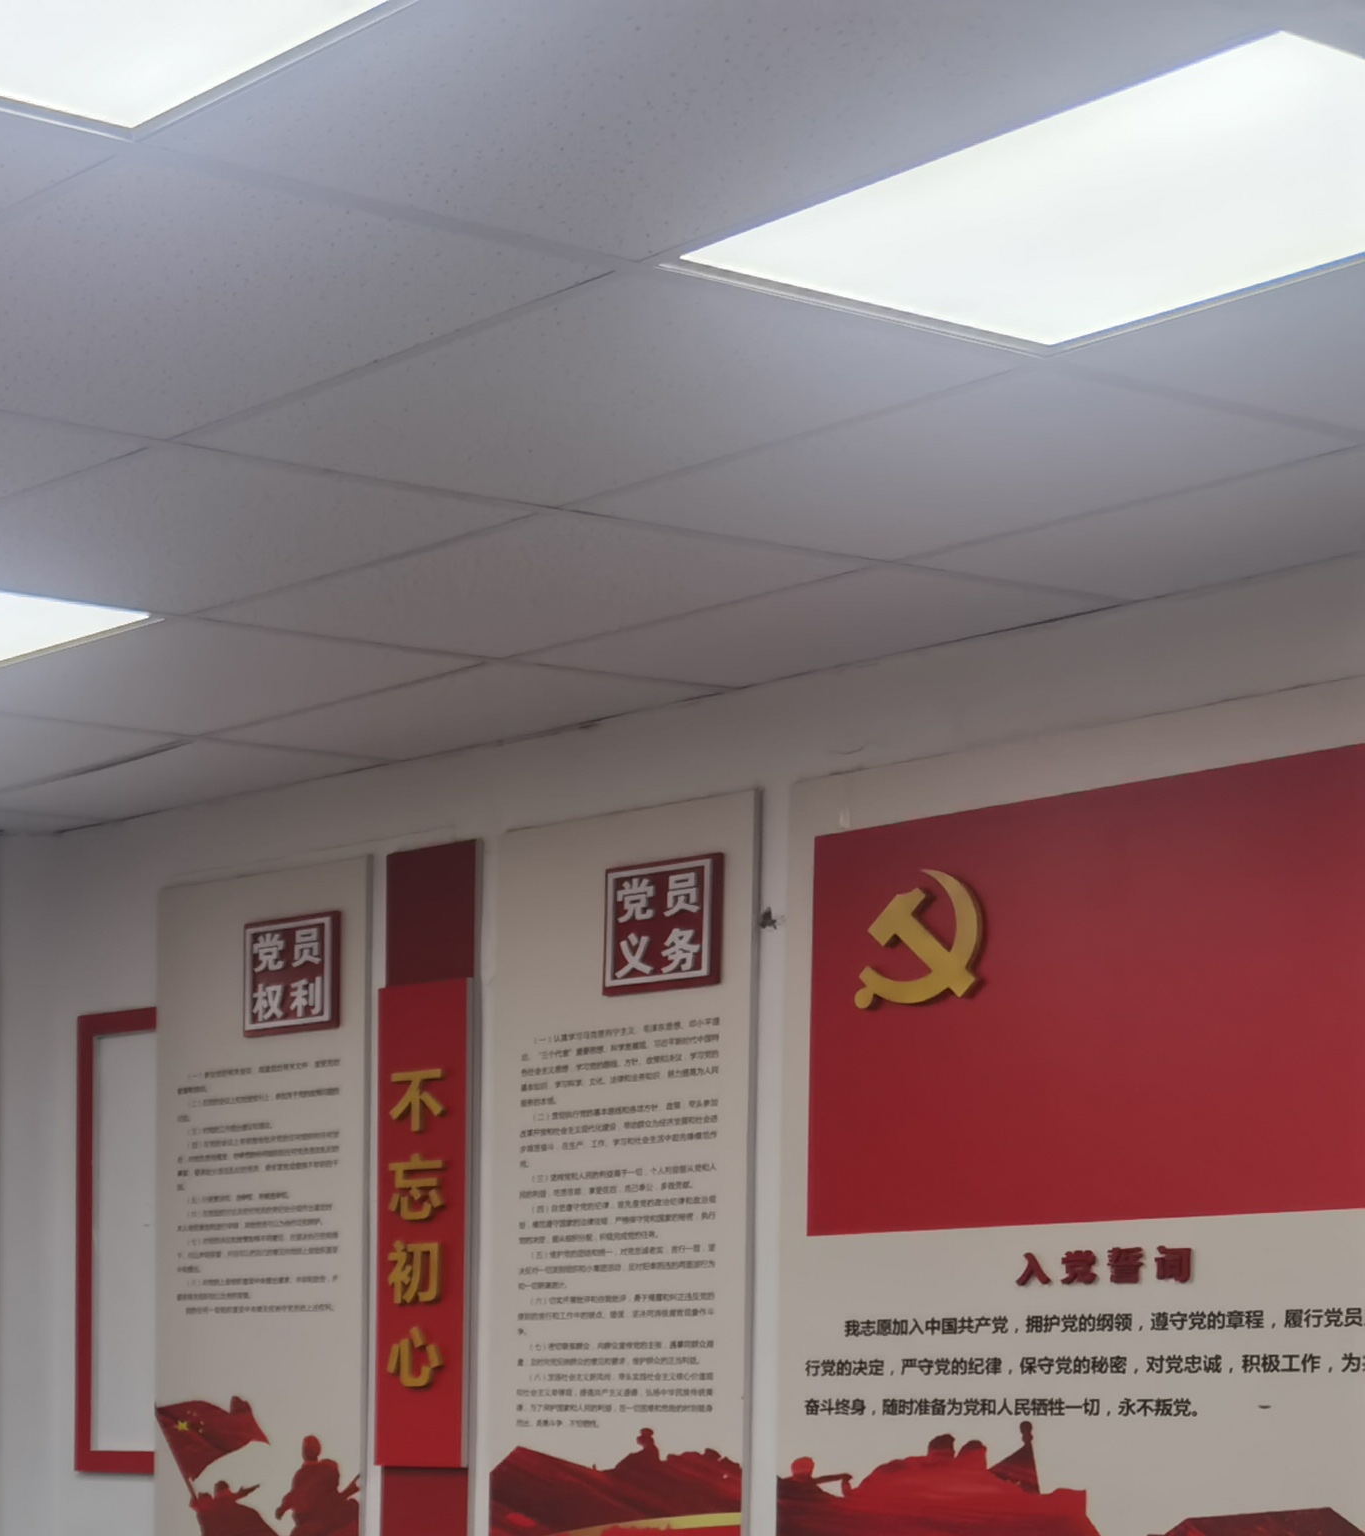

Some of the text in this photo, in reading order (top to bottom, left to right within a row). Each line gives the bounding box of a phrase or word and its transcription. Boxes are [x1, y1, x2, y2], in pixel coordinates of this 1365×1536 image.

[616, 871, 700, 923] 党员
[252, 927, 322, 974] 党员
[614, 928, 701, 979] 义务
[252, 976, 323, 1022] 权利
[387, 1067, 446, 1389] 不忘初心
[1015, 1245, 1194, 1287] 入党誓词
[843, 1307, 1365, 1337] 我志愿加入中国共产党，拥护党的纲领，遵守党的章程，履行党员
[804, 1351, 1365, 1377] 行党的决定，严守党的纪律，保守党的秘密，对党忠诚，积极工作，为
[804, 1397, 1200, 1418] 奋斗终身，随时准备为党和人民牺牲一切，永不叛党。
